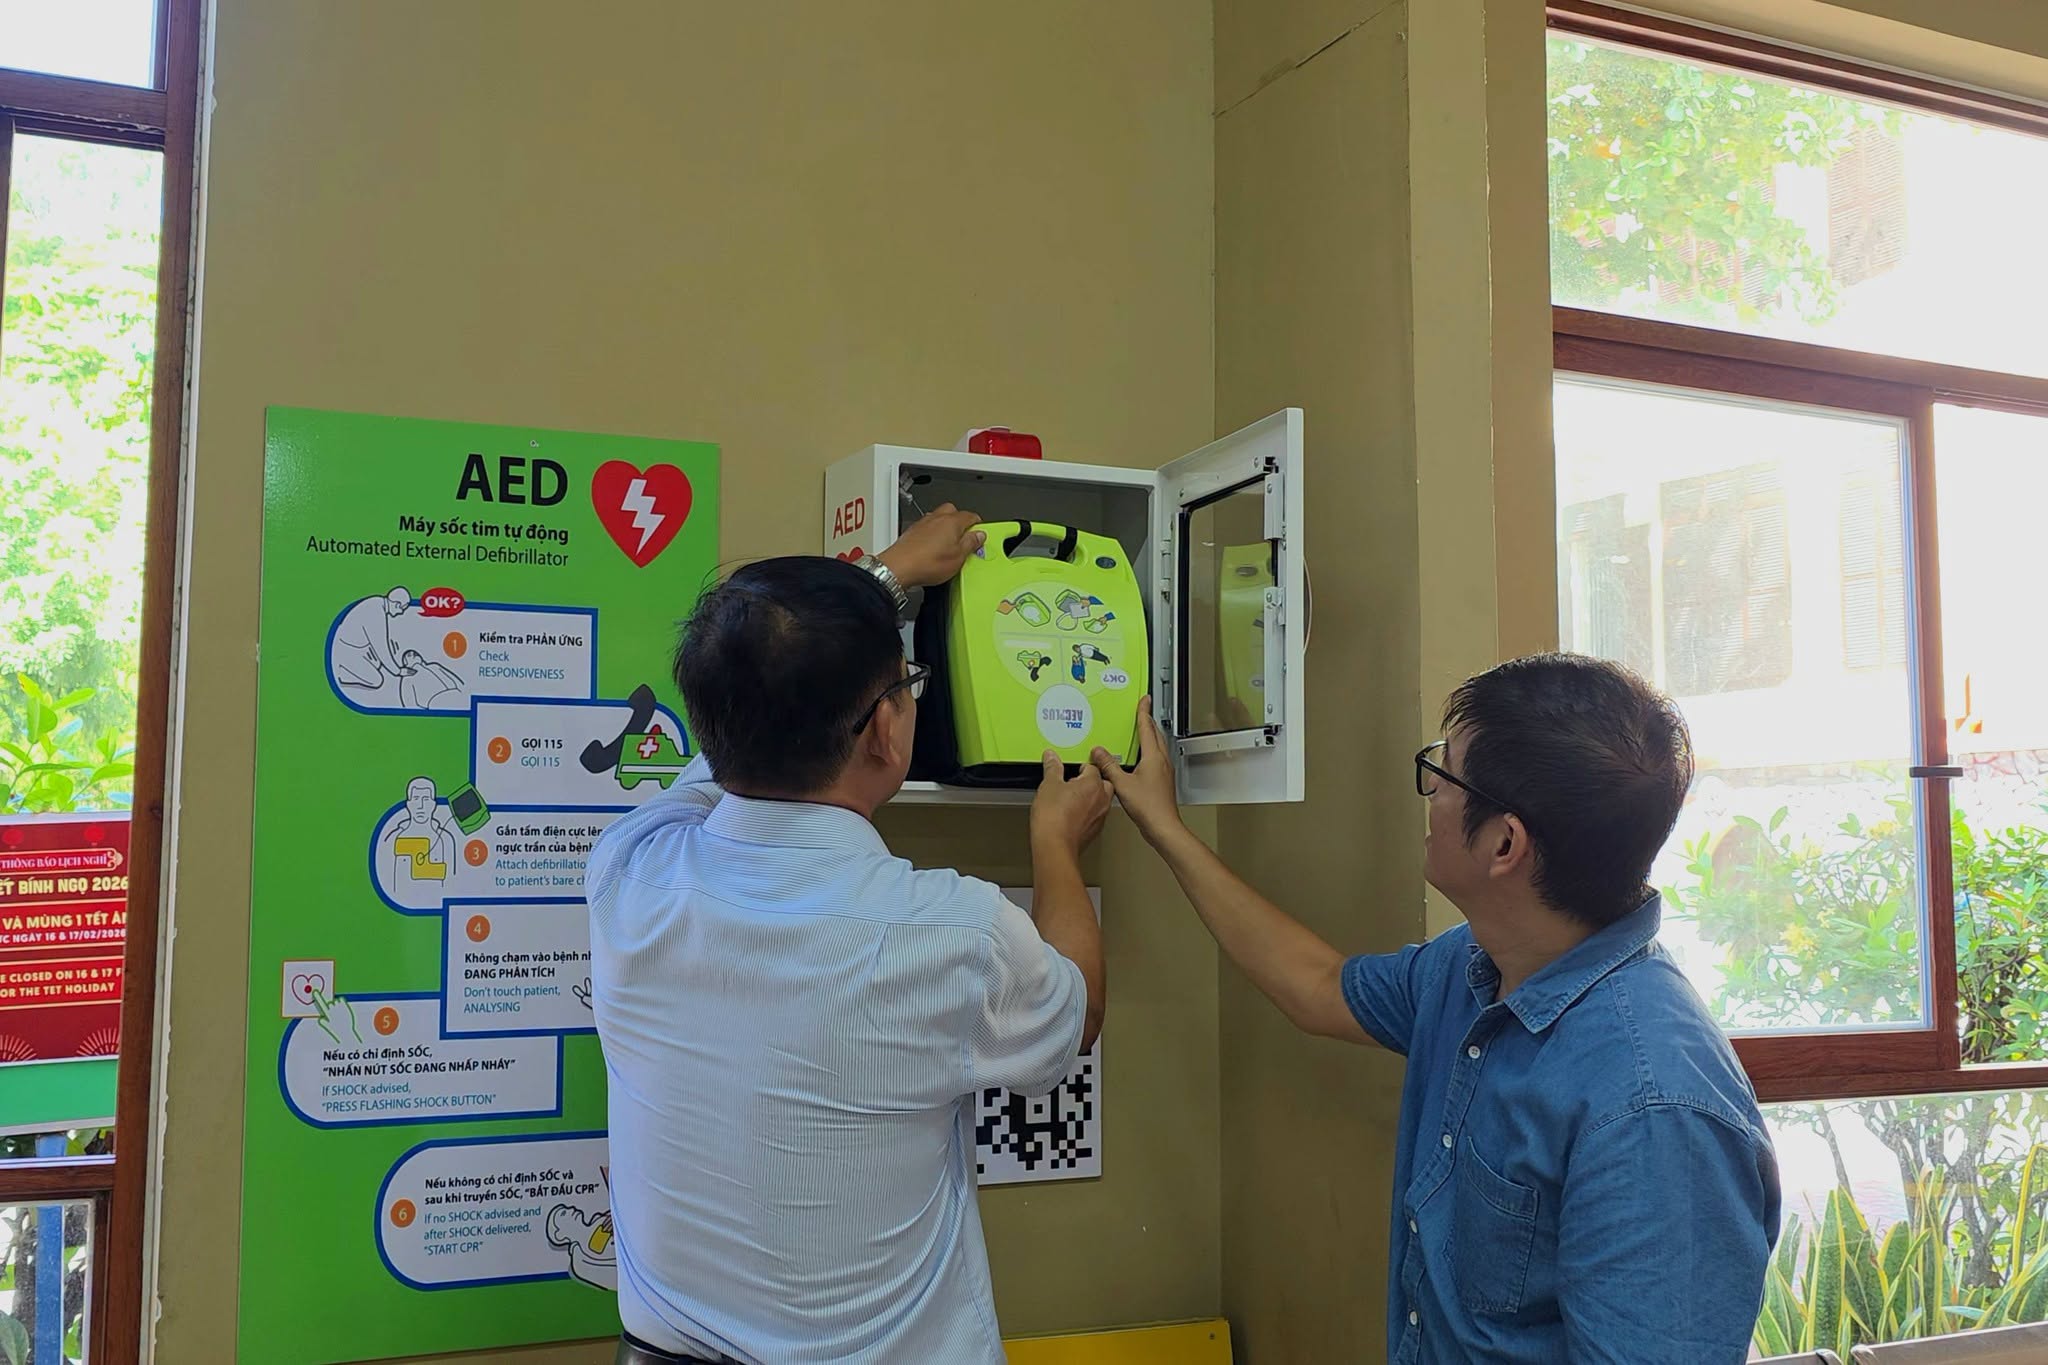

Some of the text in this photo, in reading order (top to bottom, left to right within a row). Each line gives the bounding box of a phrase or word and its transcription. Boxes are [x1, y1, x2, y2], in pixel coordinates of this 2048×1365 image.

[456, 453, 569, 507] AED
[833, 497, 865, 540] AED
[399, 516, 569, 545] Máy sốc tim tự động
[306, 535, 569, 567] Automated External Defibrillator
[424, 595, 461, 609] OK?
[452, 639, 457, 652] 1
[508, 634, 524, 644] tra
[478, 650, 510, 662] Check
[478, 666, 565, 680] RESPONSIVENESS
[1103, 674, 1127, 684] OK?
[495, 744, 503, 757] 2
[521, 738, 563, 752] GỌI 115
[520, 756, 560, 768] GỌI 115
[542, 825, 566, 840] điện
[568, 827, 586, 840] cực
[473, 847, 480, 860] 3
[495, 842, 522, 855] ngực
[548, 841, 567, 852] của
[495, 859, 528, 870] Attach
[18, 876, 54, 895] BÍNH
[57, 877, 89, 895] NGỌ
[92, 875, 128, 892] 2026
[495, 876, 506, 886] to
[508, 875, 550, 888] patient's
[552, 875, 574, 886] bare
[2, 915, 23, 931] VÀ
[26, 914, 73, 929] MÙNG
[76, 915, 82, 926] 1
[85, 911, 109, 926] TẾT
[473, 922, 481, 934] 4
[45, 932, 56, 941] 16
[59, 932, 66, 940] &
[69, 928, 126, 941] 17/02/2026
[464, 952, 499, 965] Không
[501, 951, 530, 965] chạm
[532, 951, 551, 961] vào
[553, 950, 579, 964] bệnh
[9, 971, 53, 983] CLOSED
[55, 970, 73, 980] ON
[76, 969, 88, 979] 16
[90, 968, 99, 979] &
[102, 967, 113, 977] 17
[464, 968, 497, 980] ĐANG
[531, 966, 555, 978] TÍCH
[19, 987, 40, 997] THE
[43, 985, 62, 995] TET
[65, 982, 115, 994] HOLIDAY
[464, 985, 561, 998] Don't touch patient,
[464, 1001, 521, 1014] ANALYSING
[383, 1015, 391, 1029] 5
[323, 1049, 345, 1061] Nếu
[348, 1049, 360, 1060] có
[380, 1047, 405, 1062] định
[407, 1045, 433, 1059] SỐC,
[364, 1062, 386, 1076] NÚT
[389, 1060, 412, 1074] SỐC
[414, 1061, 446, 1074] ĐANG
[449, 1058, 479, 1072] NHẤP
[322, 1082, 411, 1097] If SHOCK advised,
[359, 1098, 411, 1111] FLASHING
[414, 1096, 448, 1108] SHOCK
[425, 1177, 446, 1189] Nếu
[448, 1174, 482, 1189] không
[483, 1173, 496, 1185] có
[514, 1172, 537, 1186] định
[539, 1168, 560, 1182] SỐC
[562, 1170, 574, 1181] và
[424, 1195, 443, 1205] sau
[445, 1191, 462, 1203] khi
[499, 1186, 523, 1201] SỐC,
[399, 1207, 408, 1221] 6
[424, 1206, 542, 1225] If no SHOCK advised and
[423, 1227, 449, 1240] after
[449, 1224, 483, 1238] SHOCK
